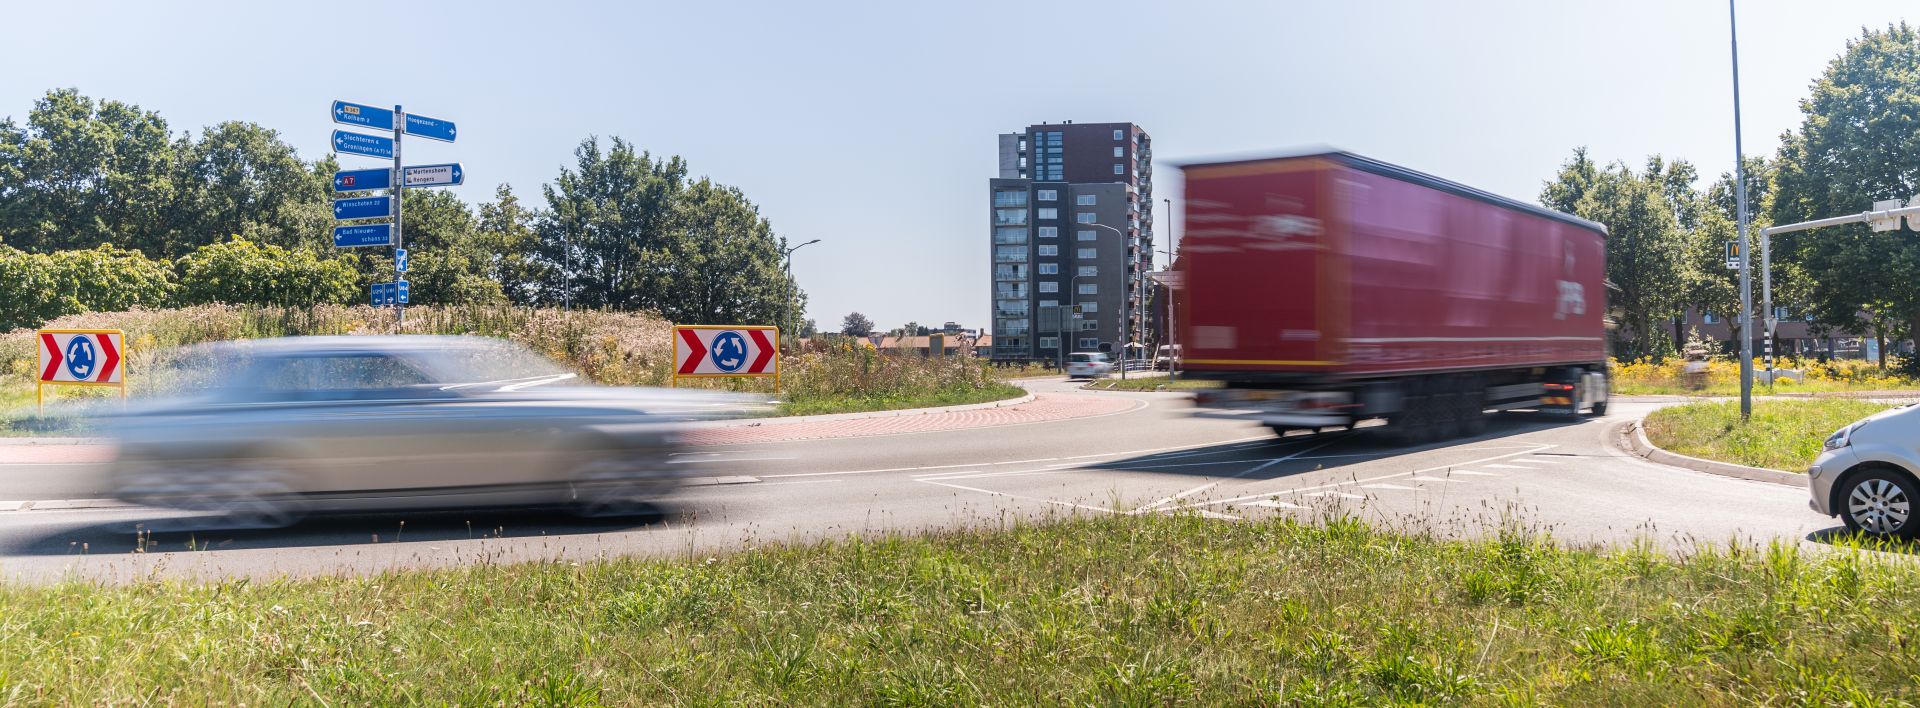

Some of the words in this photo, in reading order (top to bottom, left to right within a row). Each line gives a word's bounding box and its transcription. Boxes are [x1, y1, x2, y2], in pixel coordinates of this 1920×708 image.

[343, 113, 366, 122] Kolham
[343, 133, 375, 144] Slochteren
[343, 143, 373, 153] Groningen
[342, 200, 373, 208] Winschoten
